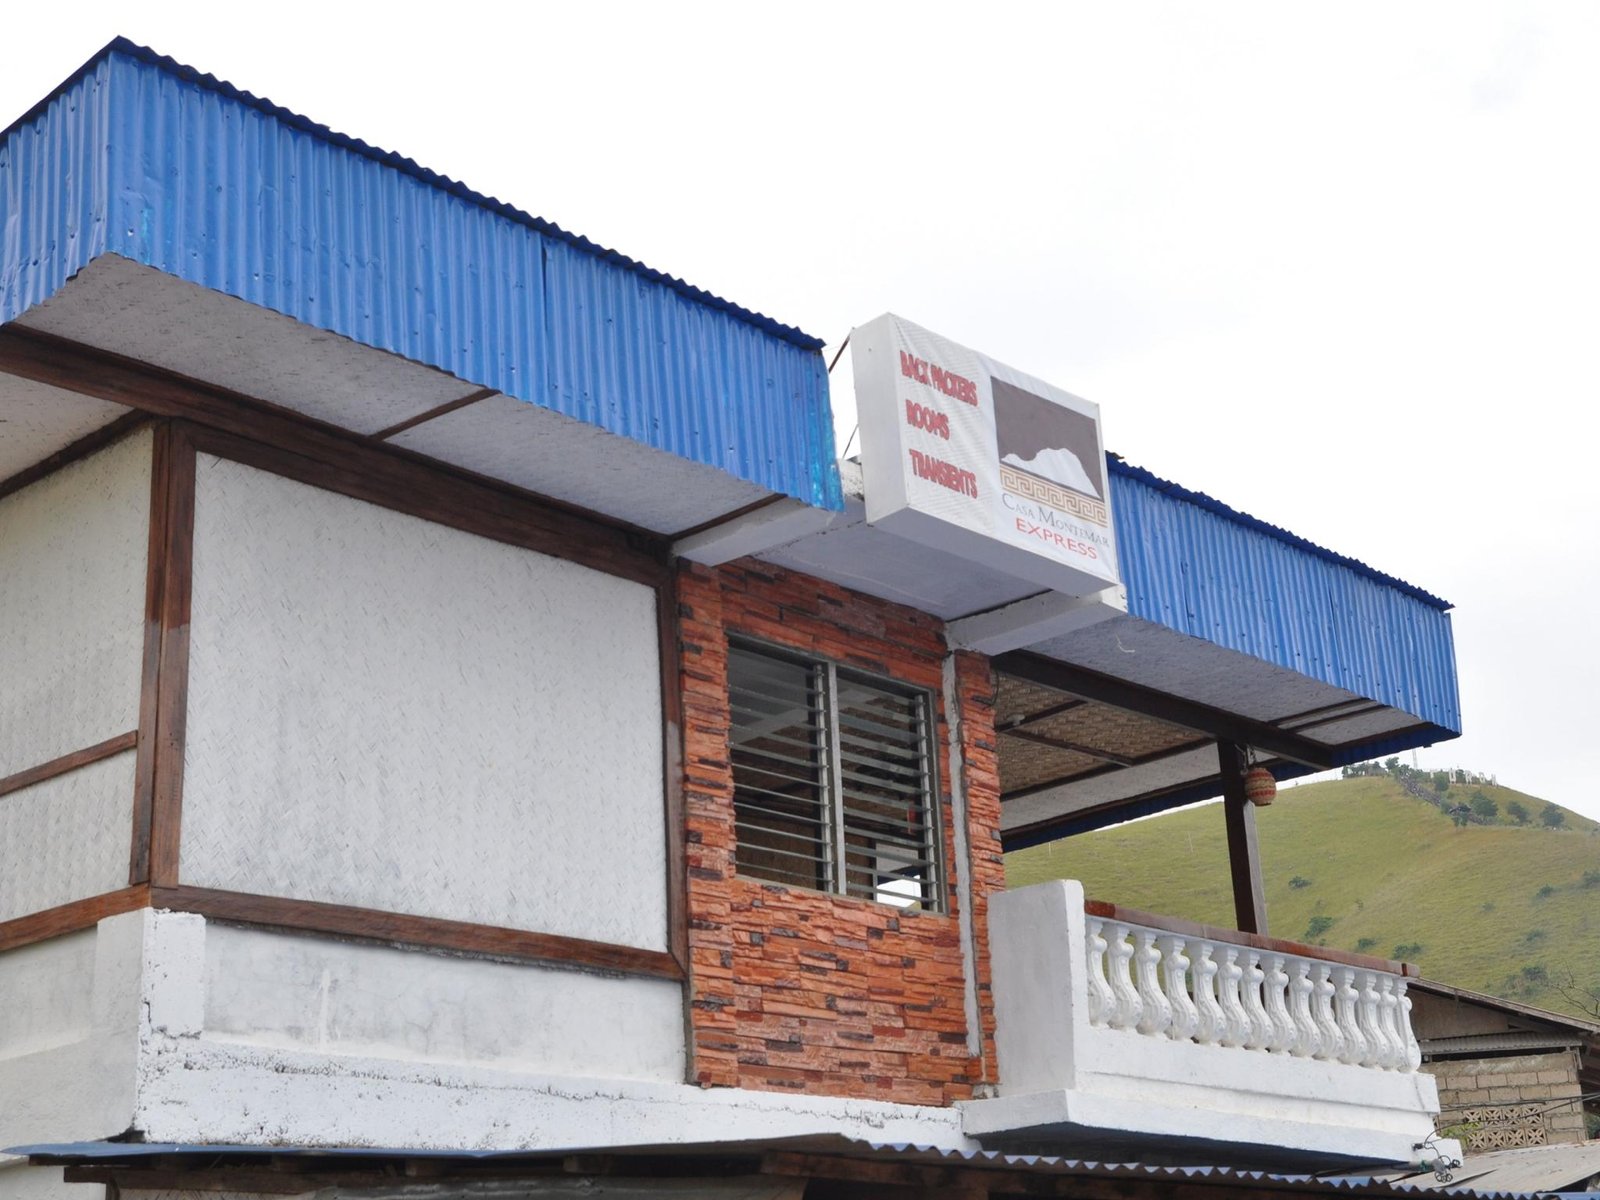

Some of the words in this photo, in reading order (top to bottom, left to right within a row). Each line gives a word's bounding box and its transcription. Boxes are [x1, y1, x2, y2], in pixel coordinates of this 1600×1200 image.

[900, 350, 932, 387] BACK
[930, 364, 978, 407] PACKERS
[905, 399, 950, 440] ROOMS
[909, 449, 978, 499] TRANSIENTS
[1016, 517, 1098, 560] EXPRESS
